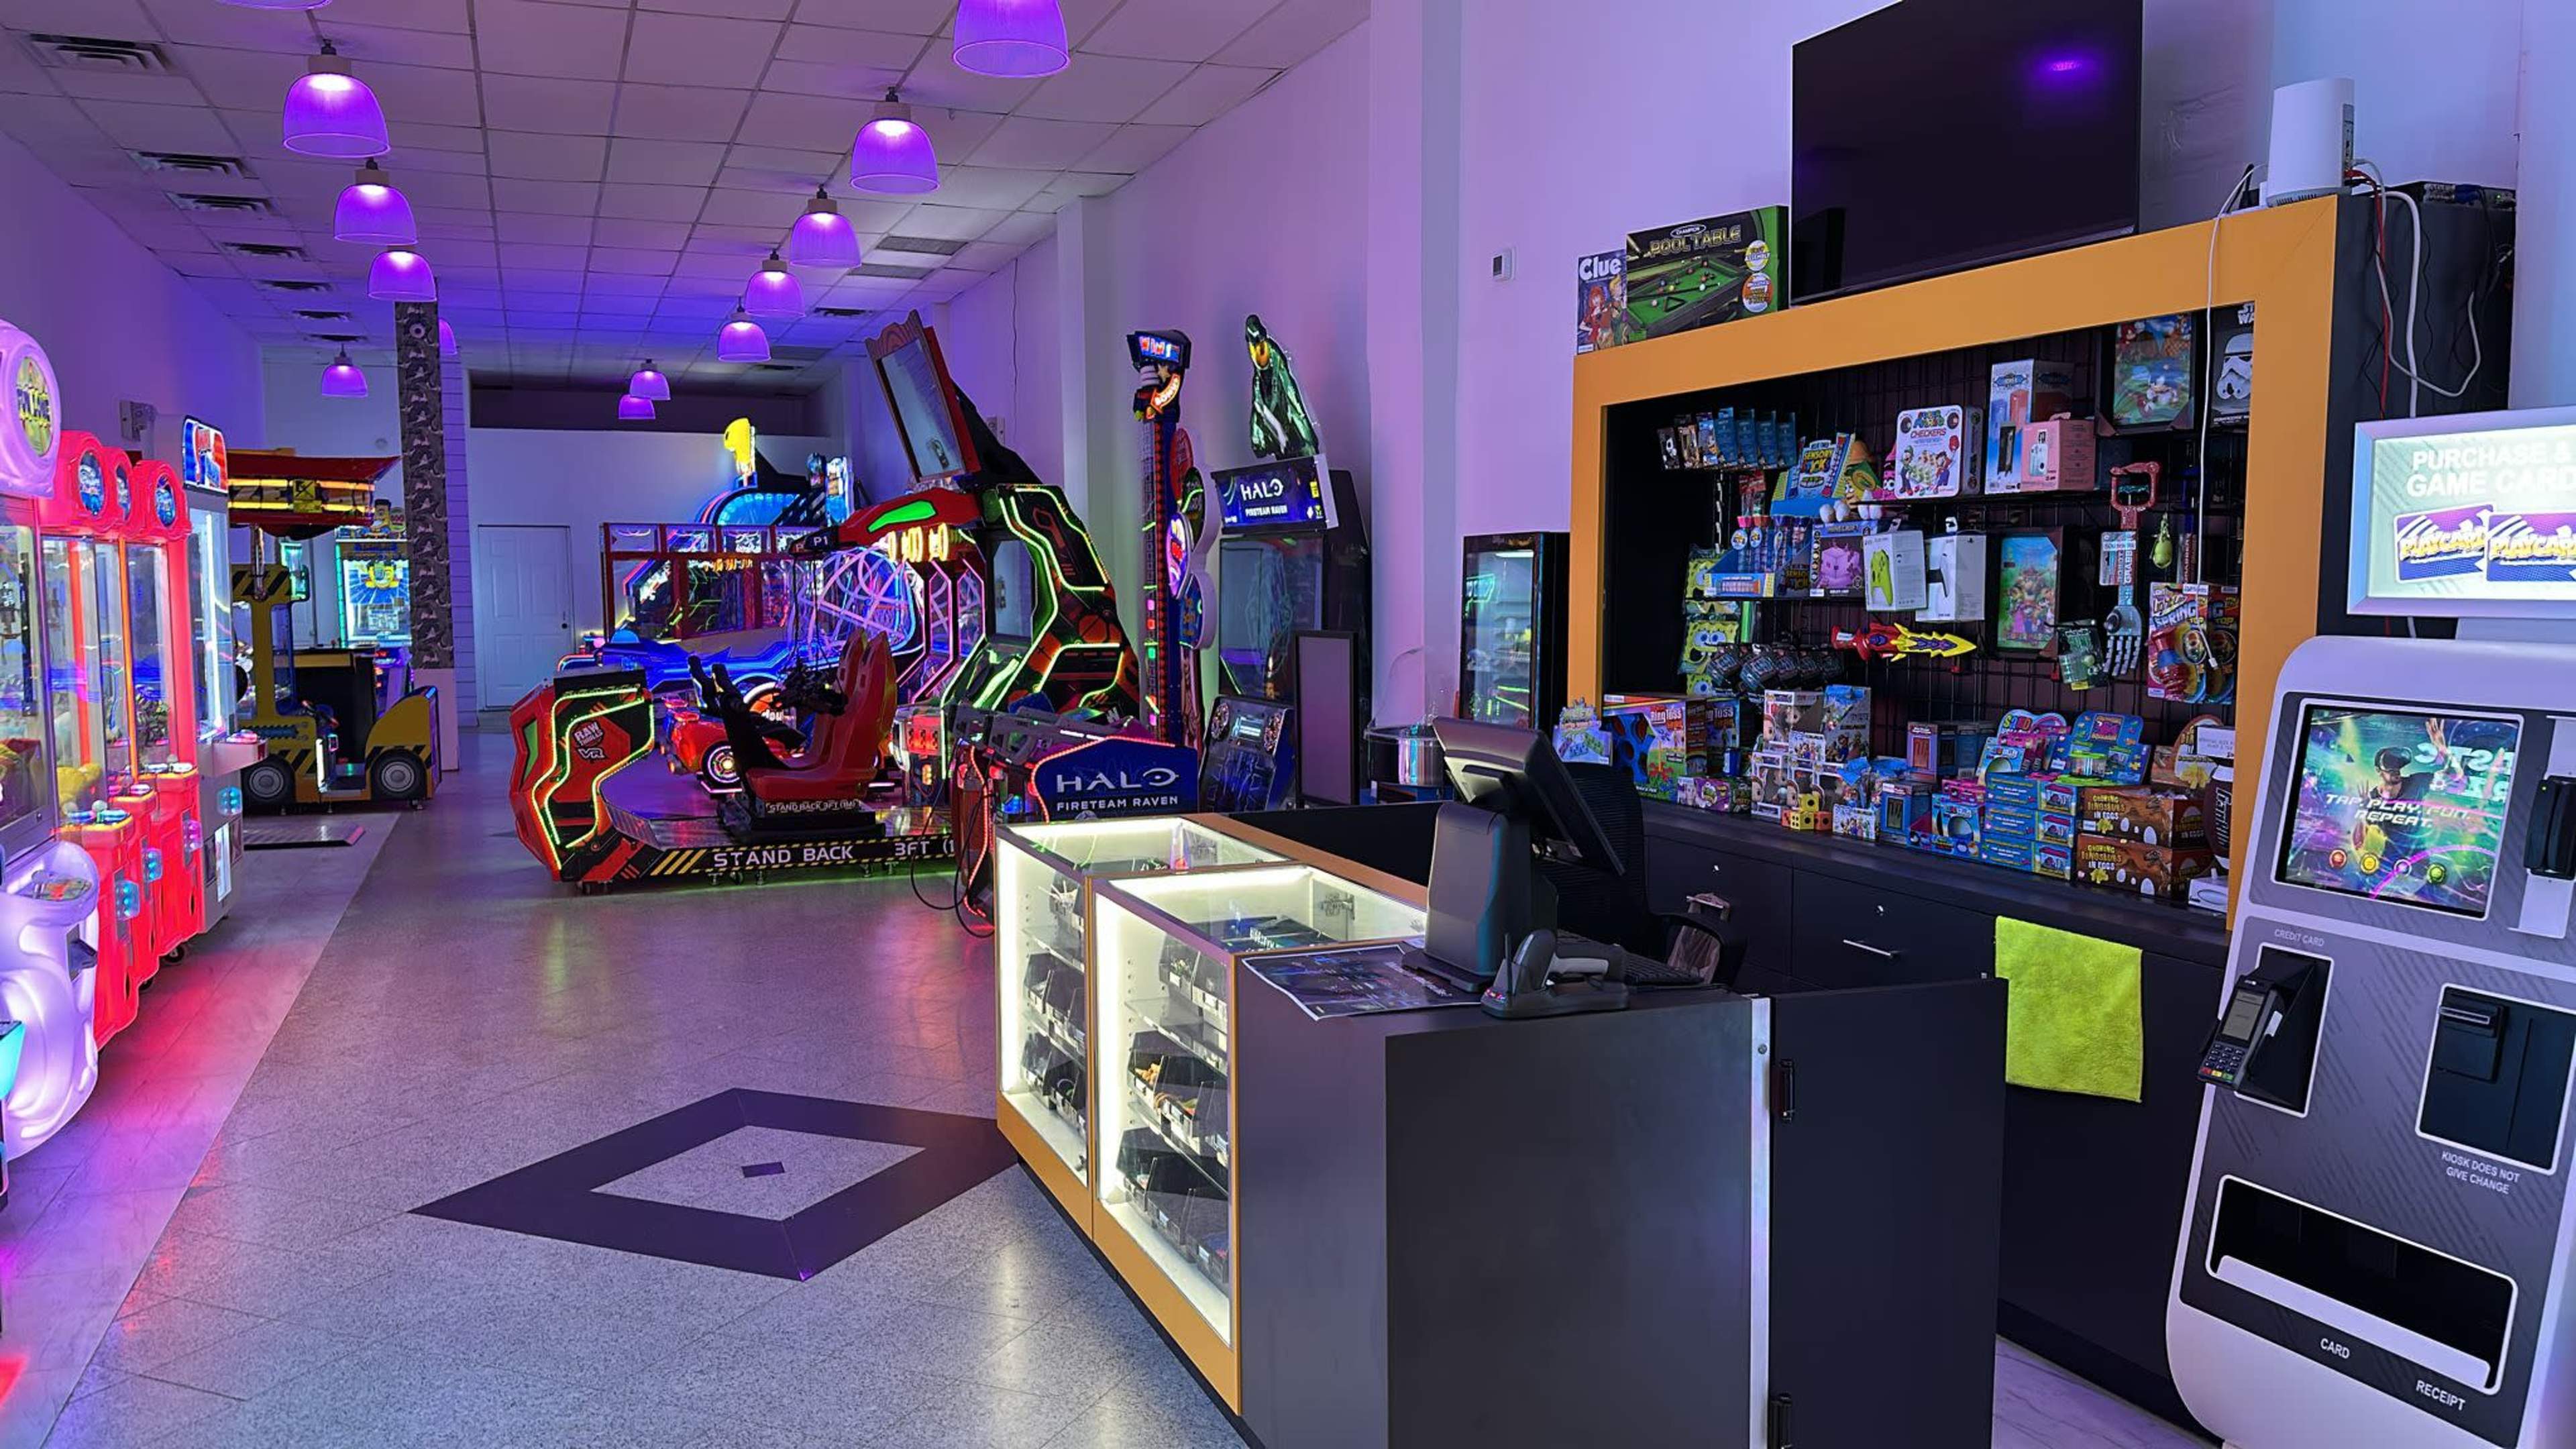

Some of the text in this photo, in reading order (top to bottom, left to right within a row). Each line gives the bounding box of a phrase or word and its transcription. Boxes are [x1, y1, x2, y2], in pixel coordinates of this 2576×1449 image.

[1650, 224, 1742, 258] POOL TABLE
[1580, 256, 1622, 281] Clue
[1911, 428, 1947, 438] CHECKERS
[2413, 440, 2571, 471] PURCHASE &
[1240, 478, 1284, 500] HALO
[2406, 470, 2486, 497] GAME
[1245, 506, 1271, 517] FIRETEAM
[814, 536, 828, 547] P1
[2154, 600, 2197, 628] SPRING
[574, 722, 600, 739] RAW
[578, 747, 605, 759] VR
[1057, 768, 1179, 793] HALO
[769, 802, 798, 812] STAND
[799, 802, 820, 811] BACK
[1057, 795, 1179, 811] FIRETEAM RAVEN
[2326, 793, 2364, 806] TAP.
[2367, 798, 2422, 815] PLAY.
[2103, 812, 2119, 820] EGGS
[2354, 809, 2432, 826] REPEAT.
[714, 848, 792, 867] STAND
[803, 845, 854, 862] BACK
[894, 841, 930, 857] 3FT
[2274, 928, 2325, 947] CREDIT CARD
[2441, 1151, 2521, 1183] KIOSK DOES NOT
[2446, 1166, 2510, 1195] GIVE CHANGE
[2320, 1338, 2350, 1359] CARD
[2415, 1379, 2466, 1411] RECEIPT
